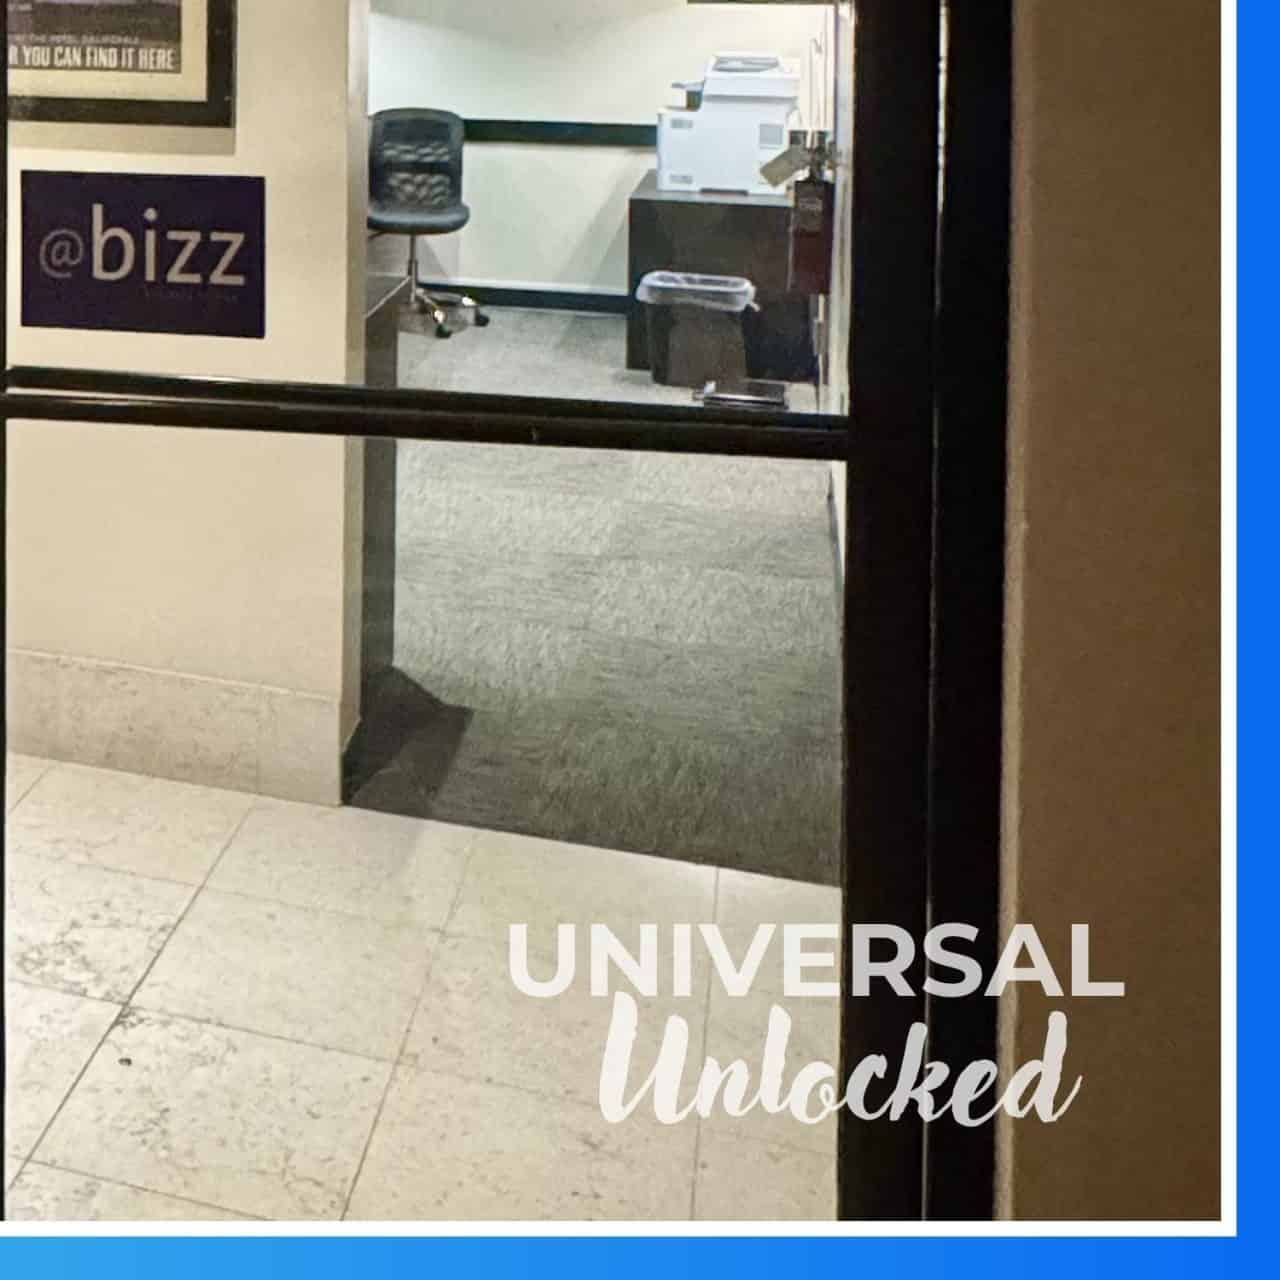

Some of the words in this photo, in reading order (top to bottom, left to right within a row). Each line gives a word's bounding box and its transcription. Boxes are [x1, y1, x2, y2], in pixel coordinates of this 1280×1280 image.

[23, 45, 51, 67] YOU
[54, 46, 82, 68] CAN
[86, 46, 118, 69] FIND
[121, 46, 135, 69] IT
[138, 47, 175, 70] HERE
[38, 202, 247, 287] @bizz
